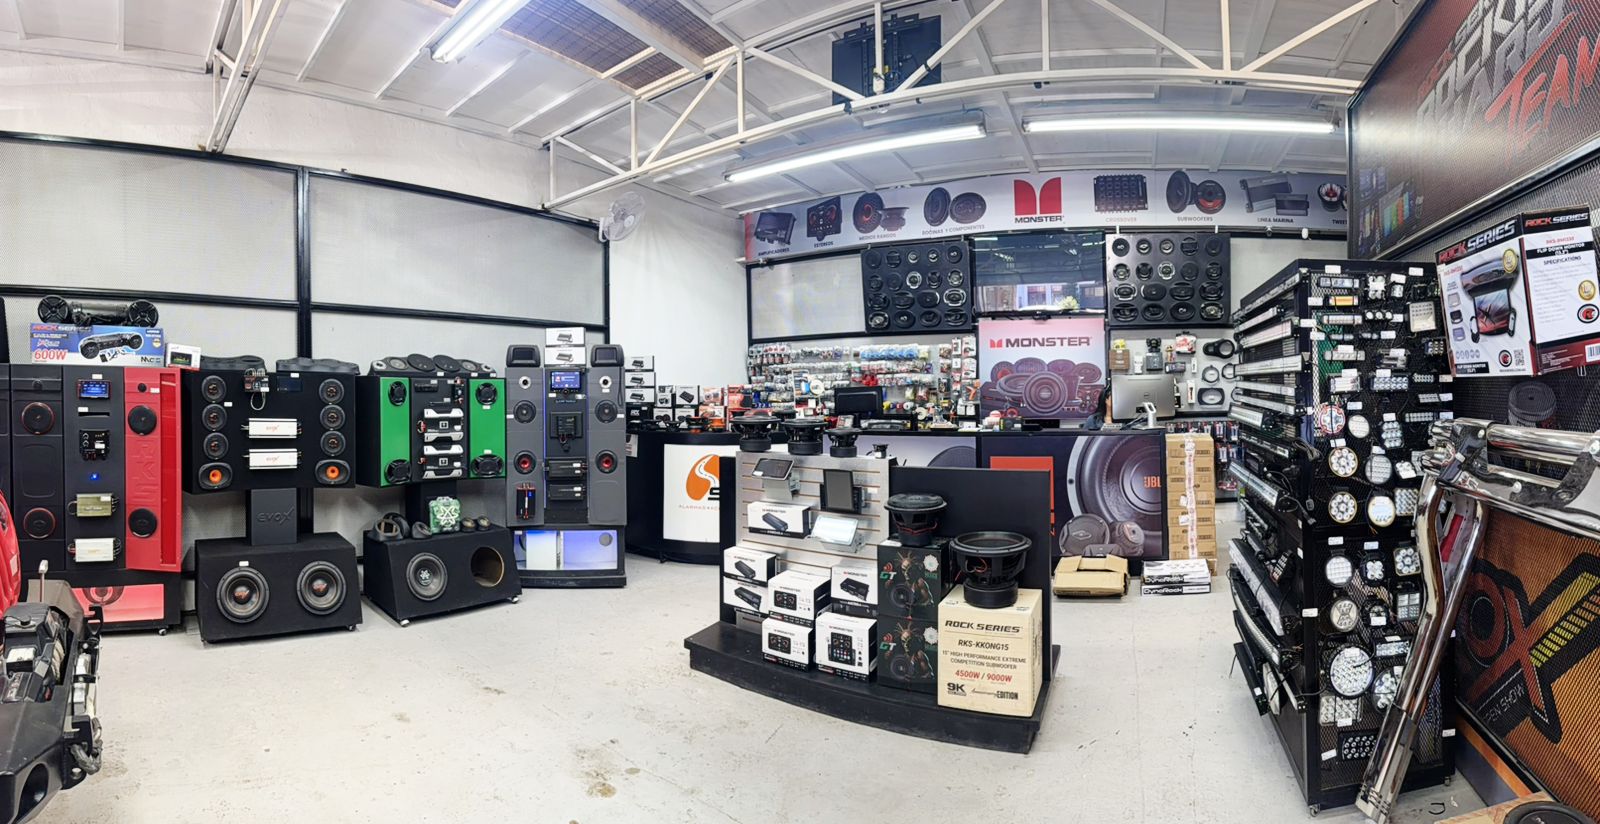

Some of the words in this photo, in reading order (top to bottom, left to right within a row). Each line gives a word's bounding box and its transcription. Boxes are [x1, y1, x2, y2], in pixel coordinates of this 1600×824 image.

[1525, 217, 1553, 227] ROCK
[1552, 213, 1589, 224] SERIES
[1438, 241, 1467, 264] ROCK
[1467, 219, 1518, 252] SERIES
[1543, 256, 1582, 266] SPECIFICATIONS
[1005, 336, 1090, 347] MONSTER
[34, 349, 68, 360] 600W
[880, 571, 897, 580] GT
[945, 620, 974, 630] ROCK
[976, 623, 1020, 633] SERIES
[957, 639, 1009, 651] RKS-KKONG15
[950, 658, 985, 667] COMPETITION
[986, 662, 1017, 670] SUBWOOFER
[963, 652, 1001, 661] PERFORMANCE
[1002, 656, 1027, 664] EXTREME
[955, 669, 981, 679] 4500W
[986, 673, 1012, 683] 9000W
[946, 682, 965, 693] 9K
[996, 690, 1019, 700] EDITION
